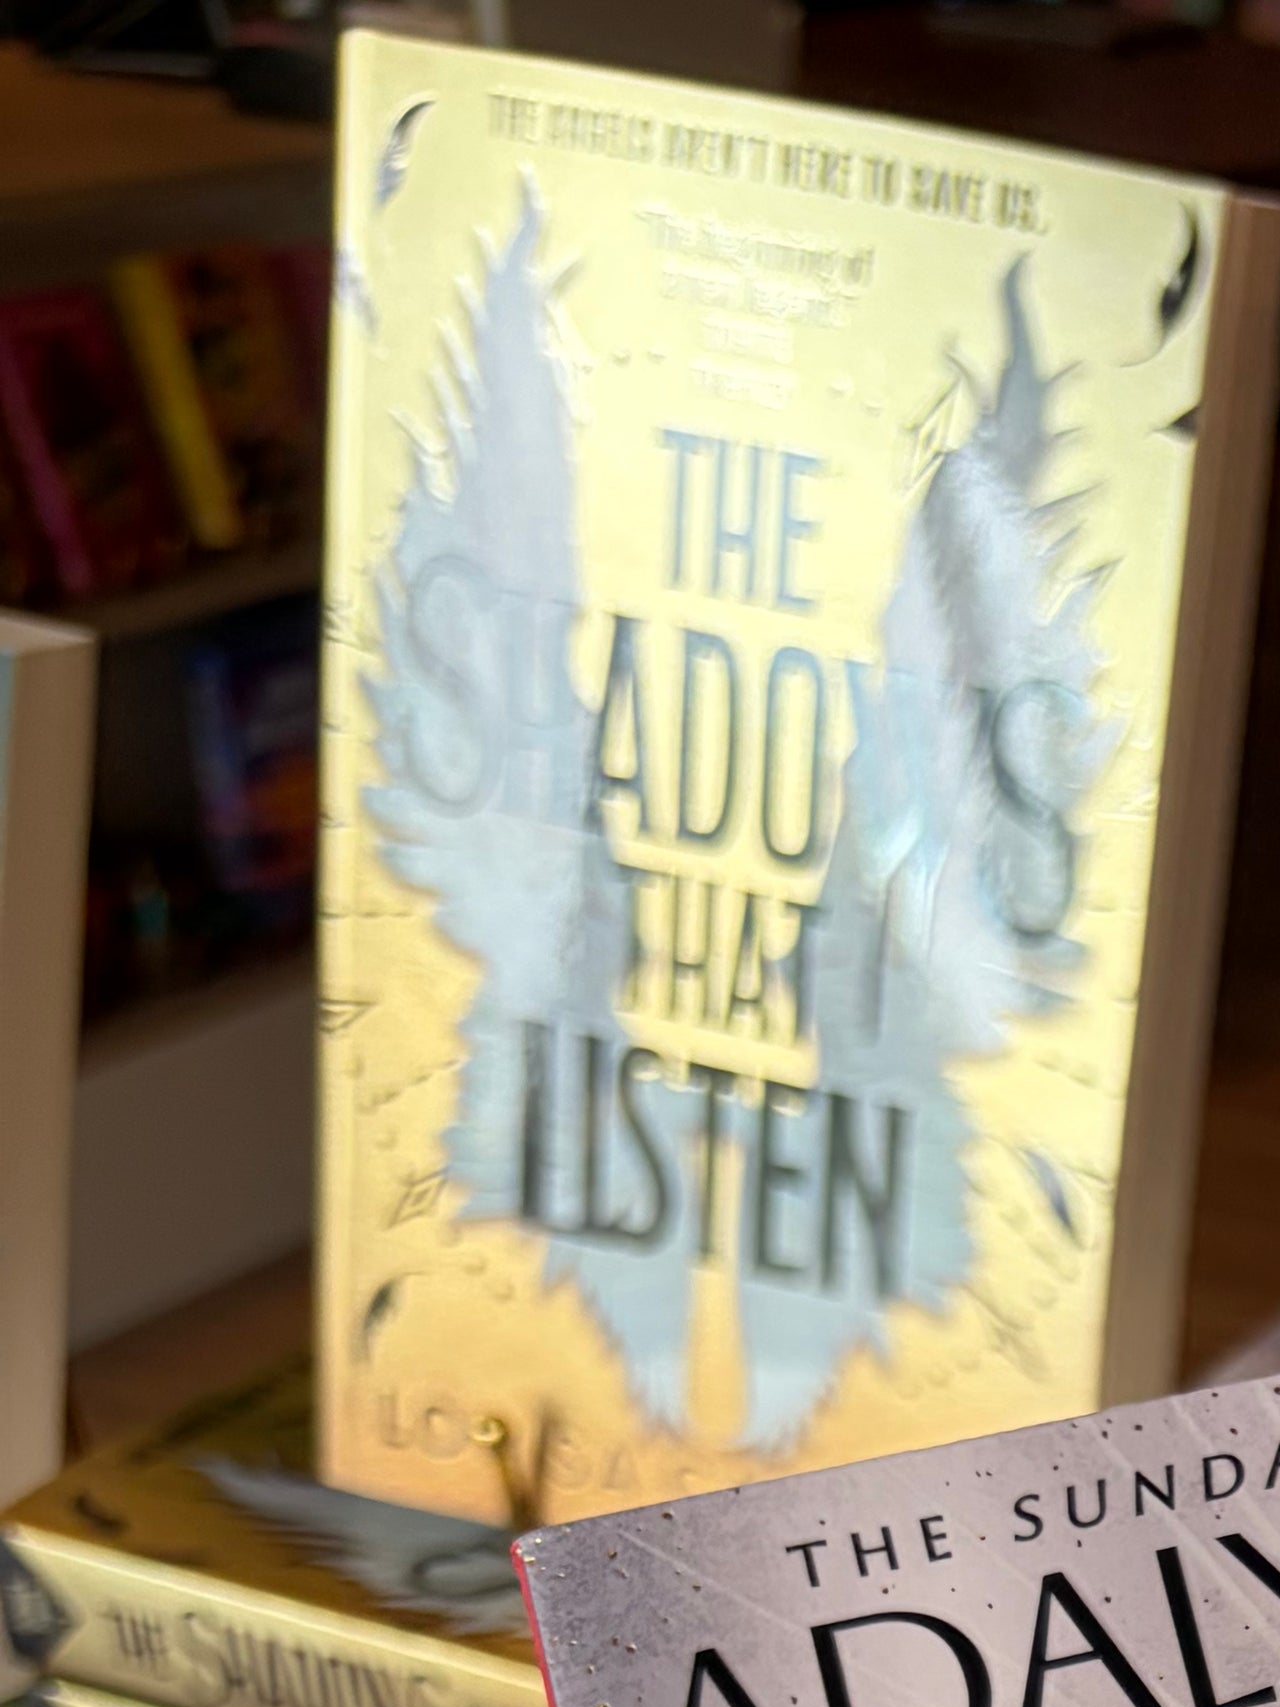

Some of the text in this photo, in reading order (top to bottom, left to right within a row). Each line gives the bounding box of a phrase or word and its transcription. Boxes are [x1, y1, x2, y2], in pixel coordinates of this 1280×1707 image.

[655, 426, 830, 614] THE
[516, 1018, 916, 1300] LISTEN
[786, 1514, 954, 1588] THE
